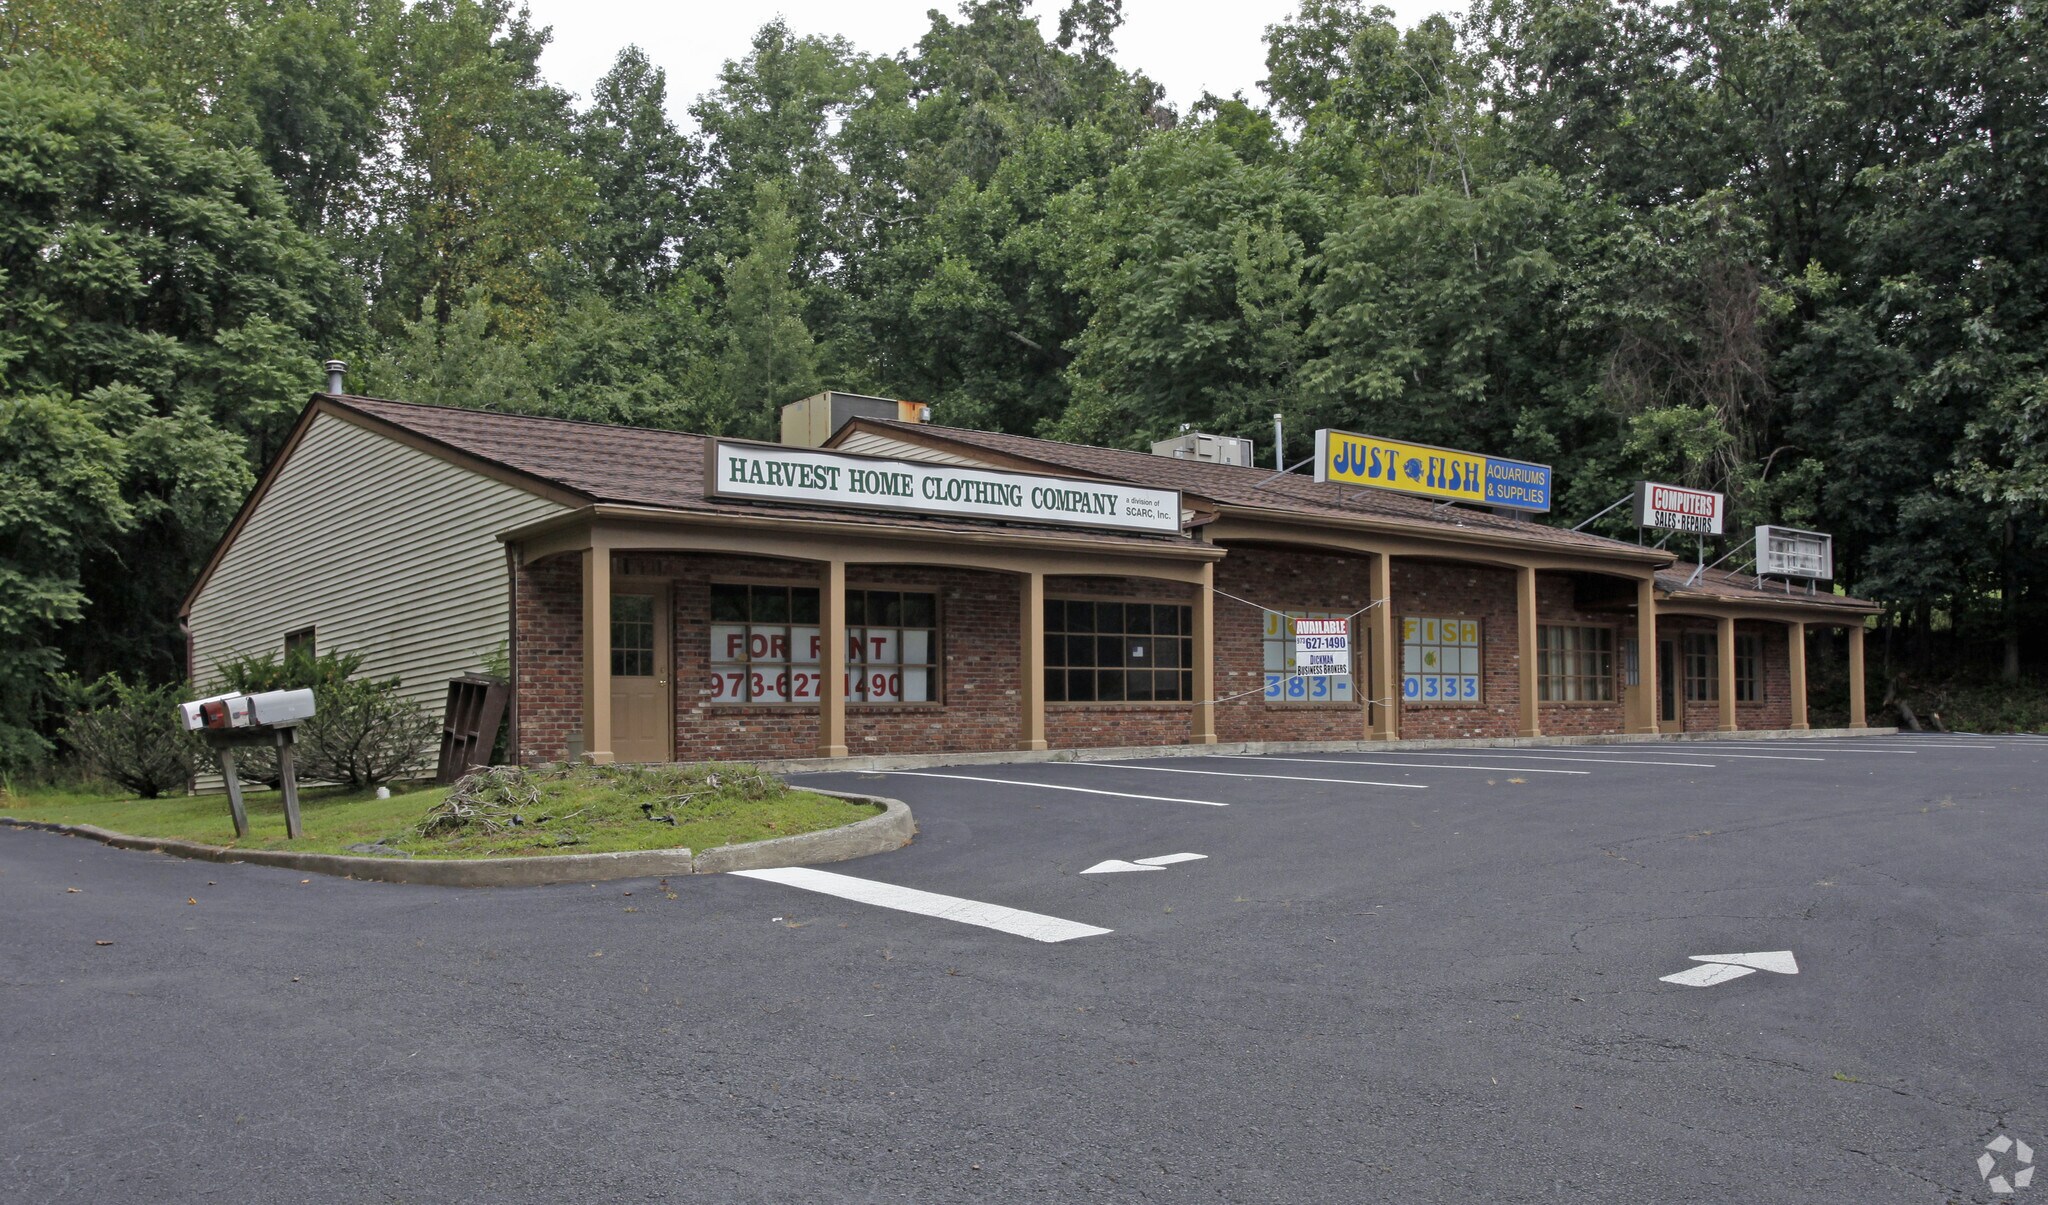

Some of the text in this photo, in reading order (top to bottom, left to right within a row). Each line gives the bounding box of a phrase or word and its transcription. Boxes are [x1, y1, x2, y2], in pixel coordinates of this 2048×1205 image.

[1333, 441, 1480, 493] JUST FISH
[1486, 464, 1545, 486] AQUARIUMS
[729, 457, 1119, 516] HARVEST HOME CLOTHING COMPANY
[1487, 483, 1544, 503] & SUPPLIES
[1131, 498, 1152, 506] division
[1655, 488, 1713, 516] COMPUTERS
[1126, 507, 1171, 519] SCARC, Inc.
[1655, 511, 1712, 533] SALES REPAIRS
[1296, 620, 1346, 634] AVAILABLE
[1405, 621, 1476, 642] FISH
[727, 634, 887, 660] FOR RNT
[1306, 637, 1346, 649] 627-1490
[1297, 664, 1347, 675] BUSINESS BROKERS
[1310, 655, 1334, 665] DICKMAN
[1405, 677, 1476, 697] 0333
